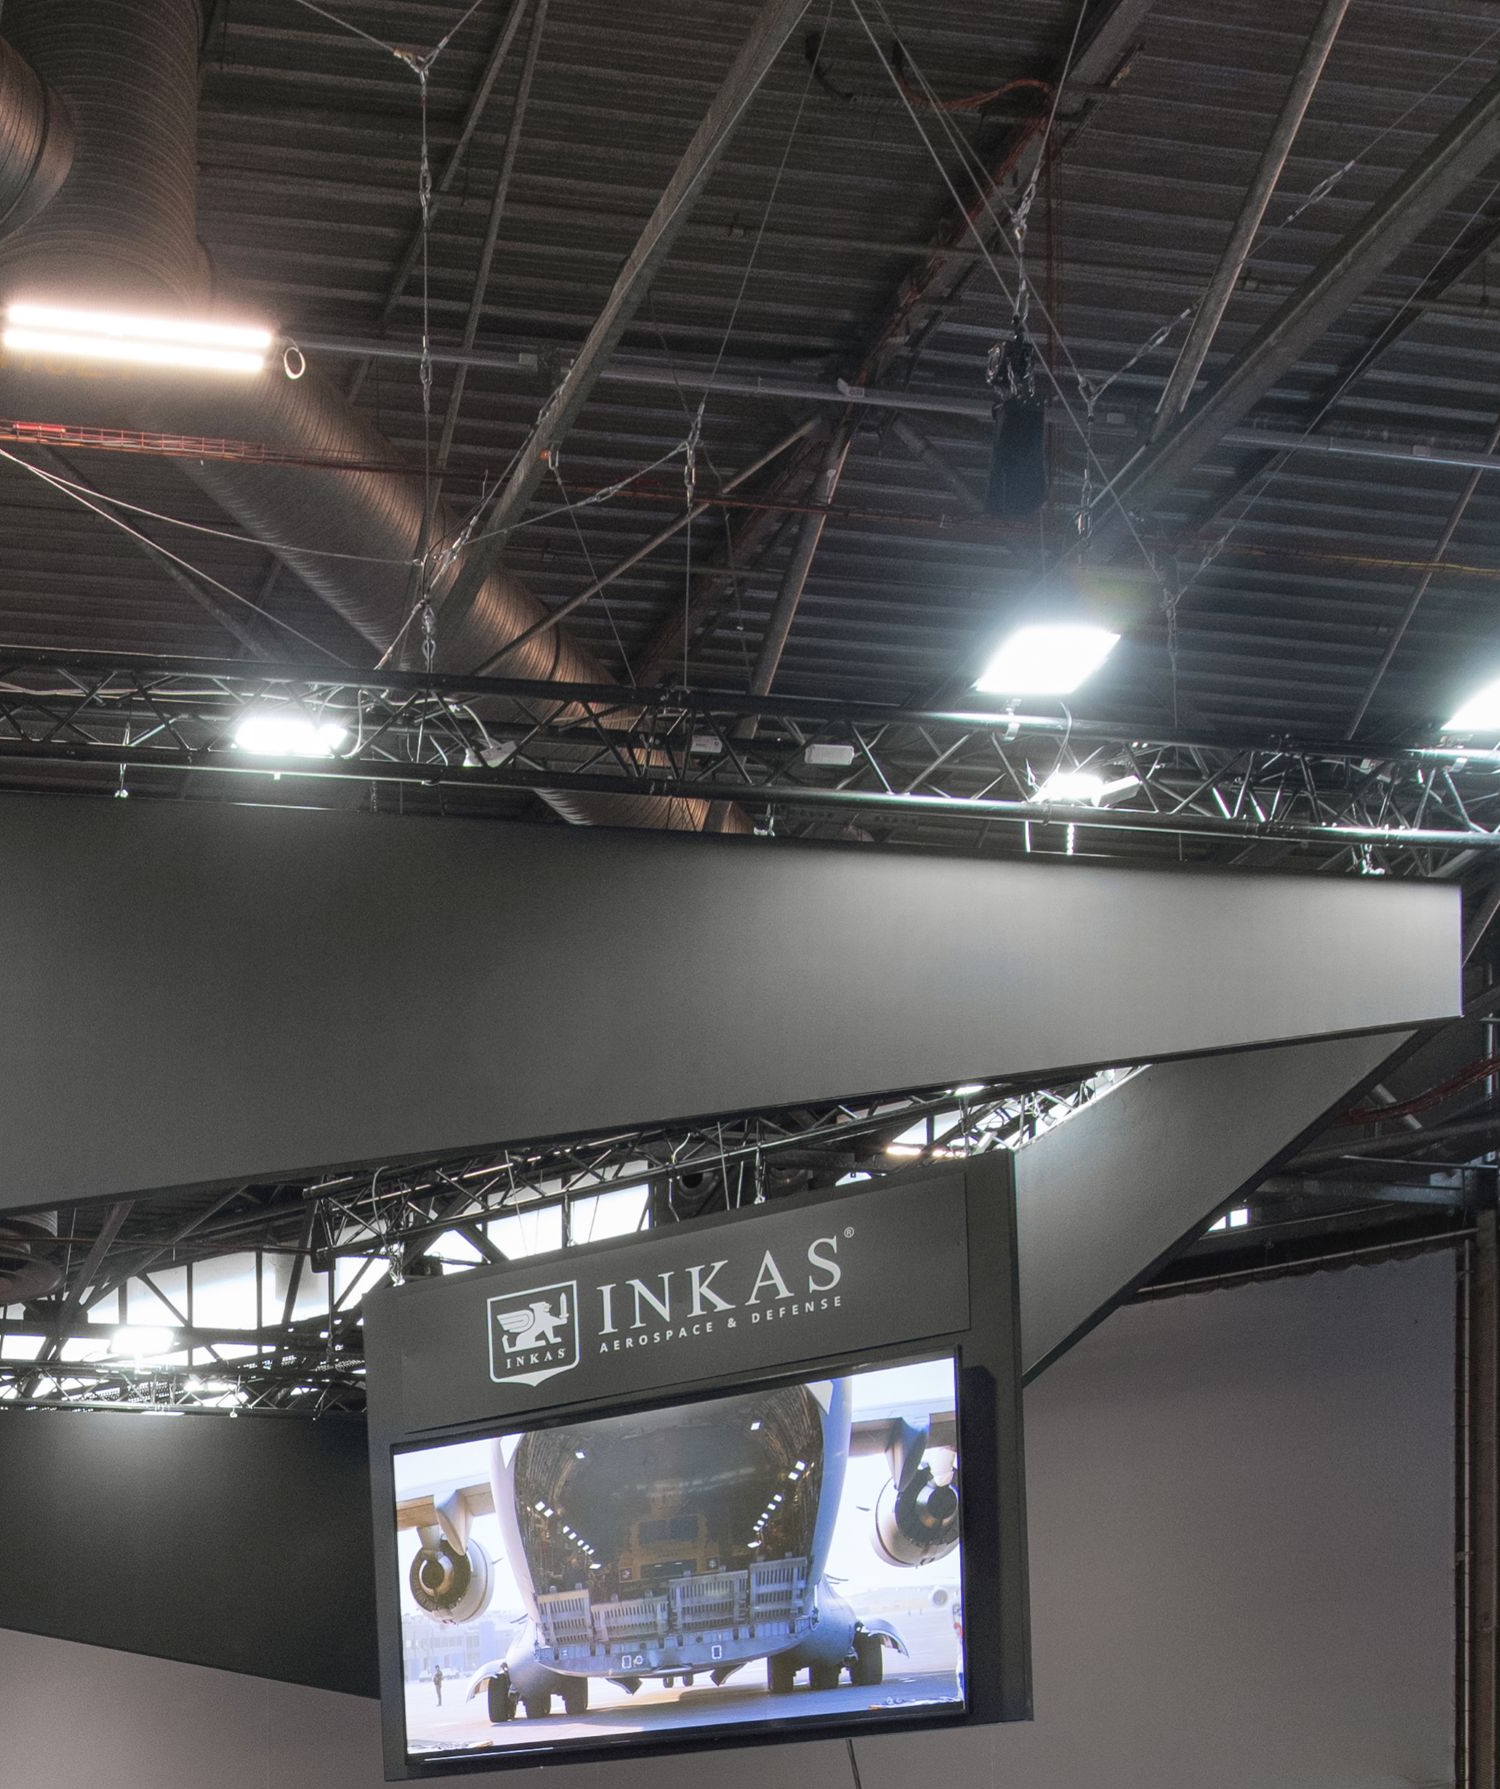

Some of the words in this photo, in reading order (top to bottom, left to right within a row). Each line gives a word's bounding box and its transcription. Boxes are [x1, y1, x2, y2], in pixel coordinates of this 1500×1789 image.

[599, 1321, 714, 1353] AEROSPACE
[727, 1318, 738, 1329] &
[751, 1296, 843, 1324] DEFENSE
